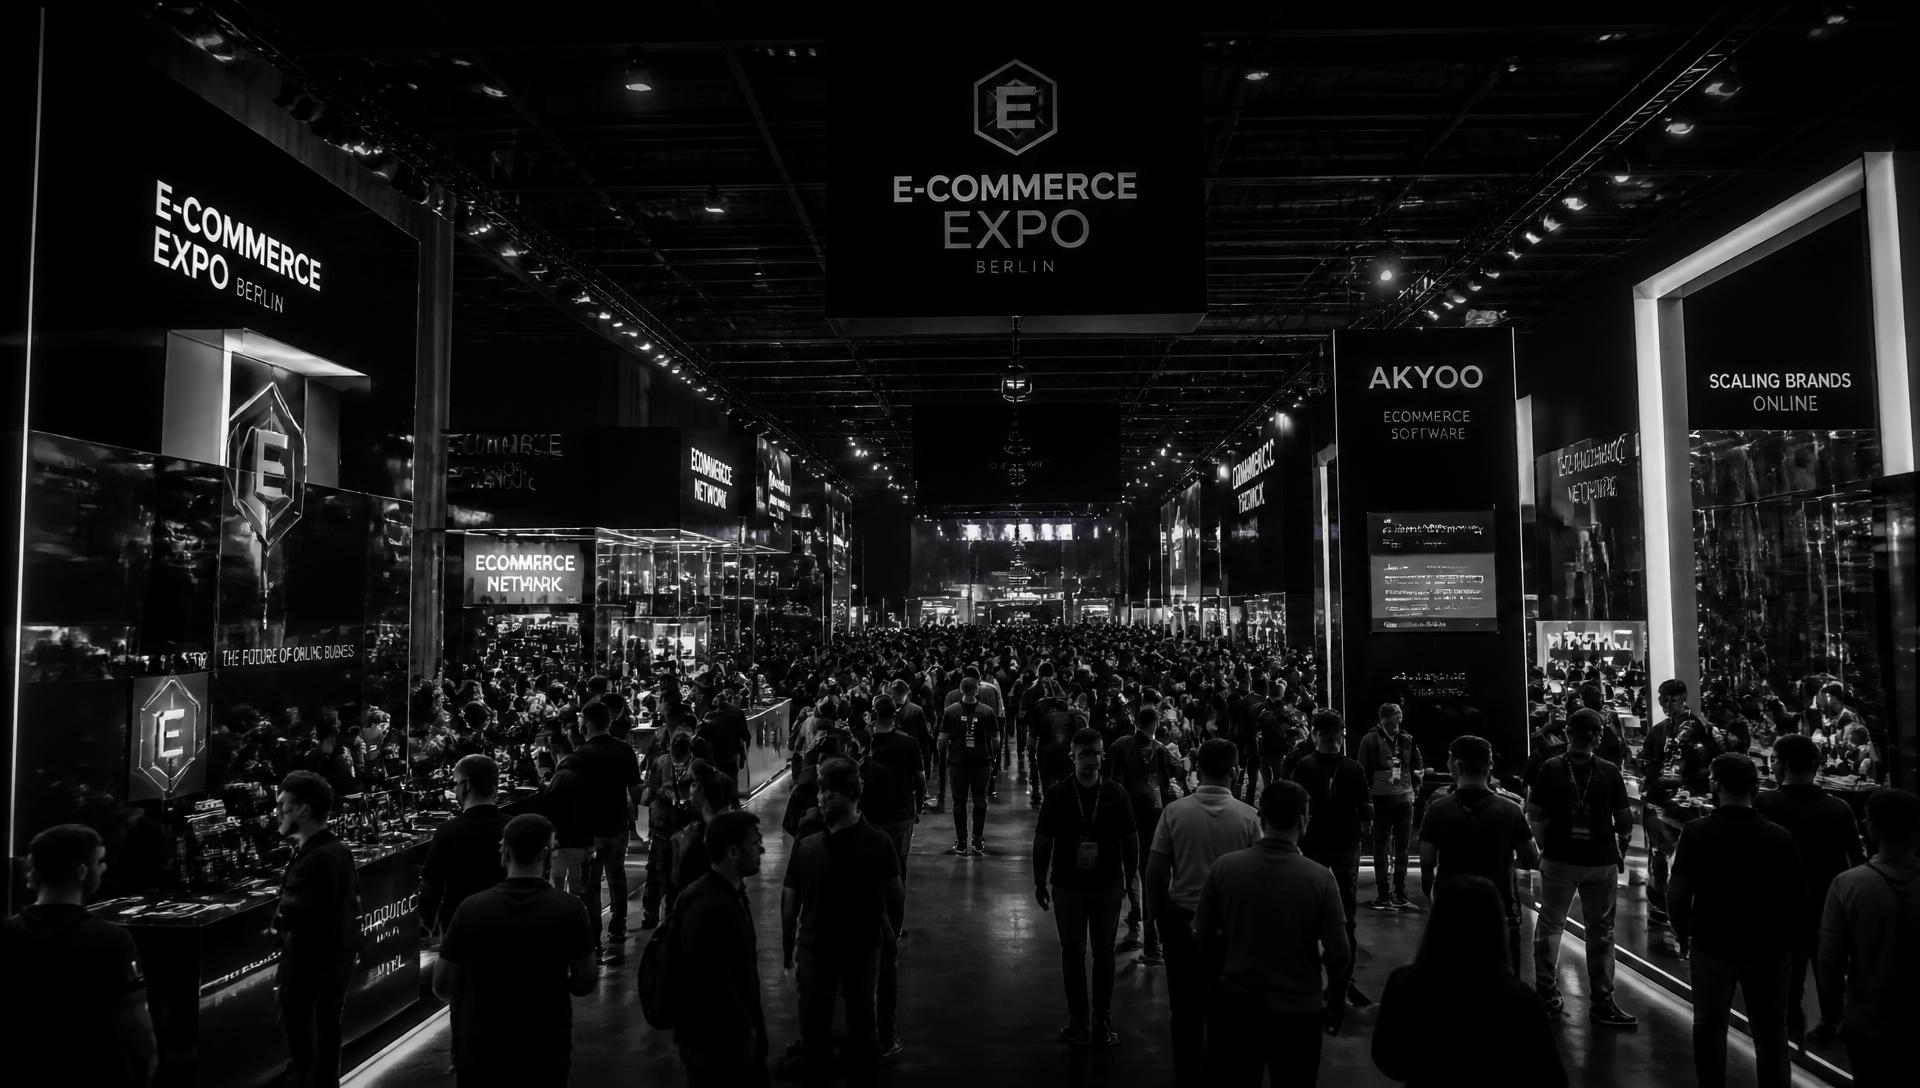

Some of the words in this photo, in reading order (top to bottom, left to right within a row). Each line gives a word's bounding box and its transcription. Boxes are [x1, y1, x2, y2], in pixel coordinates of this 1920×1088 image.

[996, 86, 1036, 129] E
[893, 172, 1138, 203] E-COMMERCE
[155, 179, 322, 292] E-COMMERCE
[944, 208, 1090, 249] EXPO
[153, 225, 229, 290] EXPO
[236, 277, 284, 314] BERLIN
[976, 260, 1055, 274] BERLIN
[1368, 365, 1483, 389] AKYOO
[1709, 373, 1780, 389] SCALING
[1785, 372, 1852, 389] BRANDS
[1753, 395, 1819, 412] ONLINE
[222, 649, 240, 667] THE
[279, 647, 293, 663] OF
